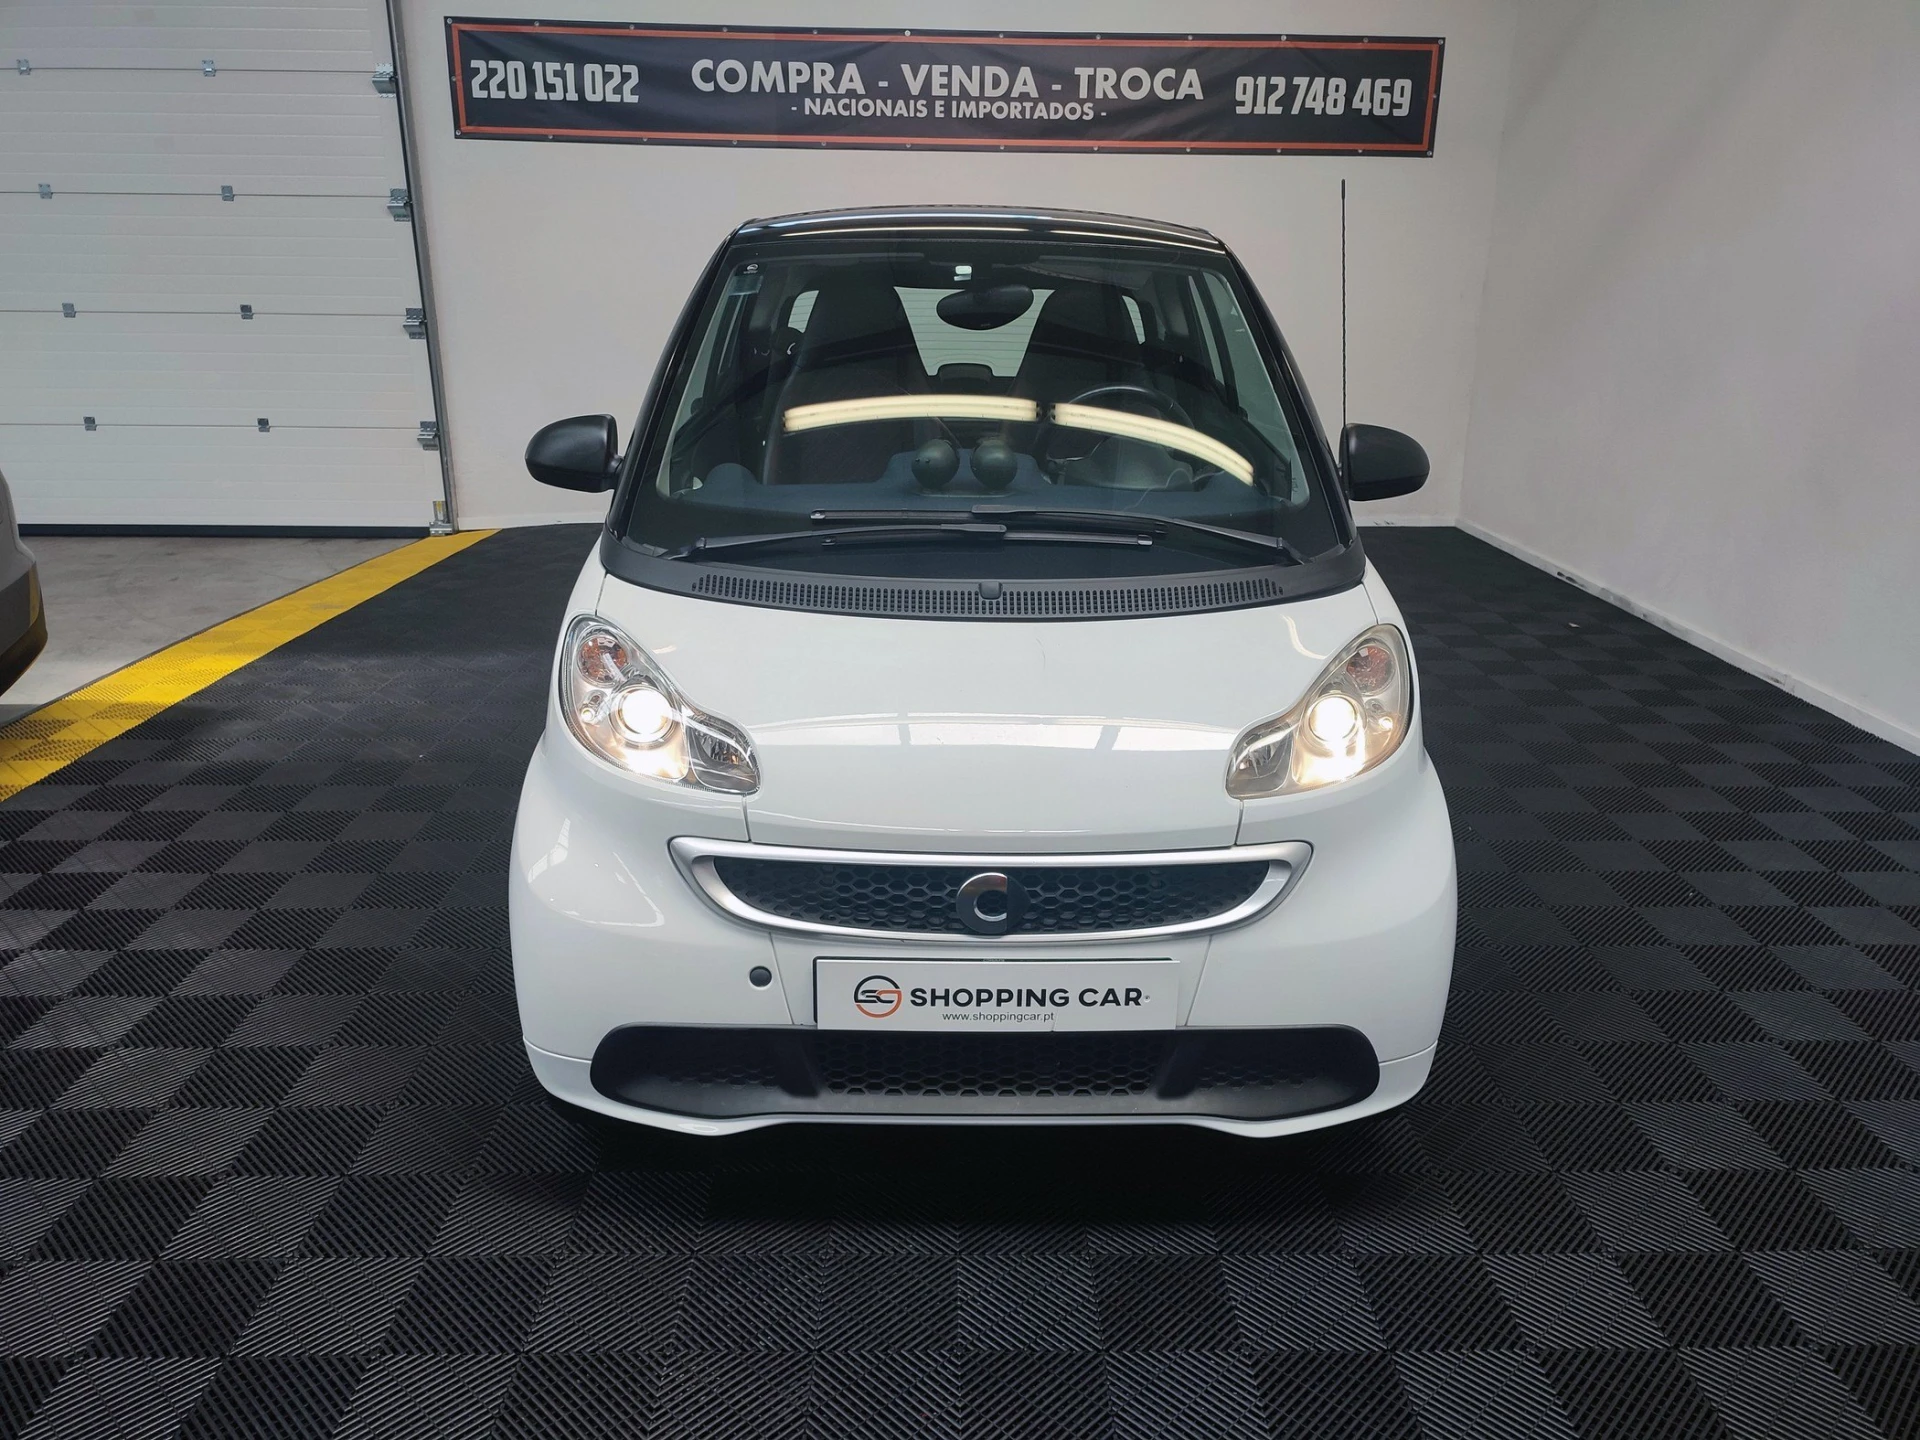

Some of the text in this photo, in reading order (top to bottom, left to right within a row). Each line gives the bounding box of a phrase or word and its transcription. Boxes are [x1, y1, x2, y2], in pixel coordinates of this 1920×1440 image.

[470, 59, 640, 103] 220 151 022
[691, 58, 866, 95] COMPRA
[900, 63, 1039, 98] VENDA
[1074, 66, 1204, 101] TROCA
[1235, 75, 1413, 117] 912 748 469
[804, 97, 928, 118] NACIONAIS
[934, 100, 945, 118] E
[951, 100, 1094, 121] IMPORTADOS
[910, 987, 1143, 1008] SHOPPING CAR
[941, 1011, 1055, 1023] www.shoppingcar.pt
